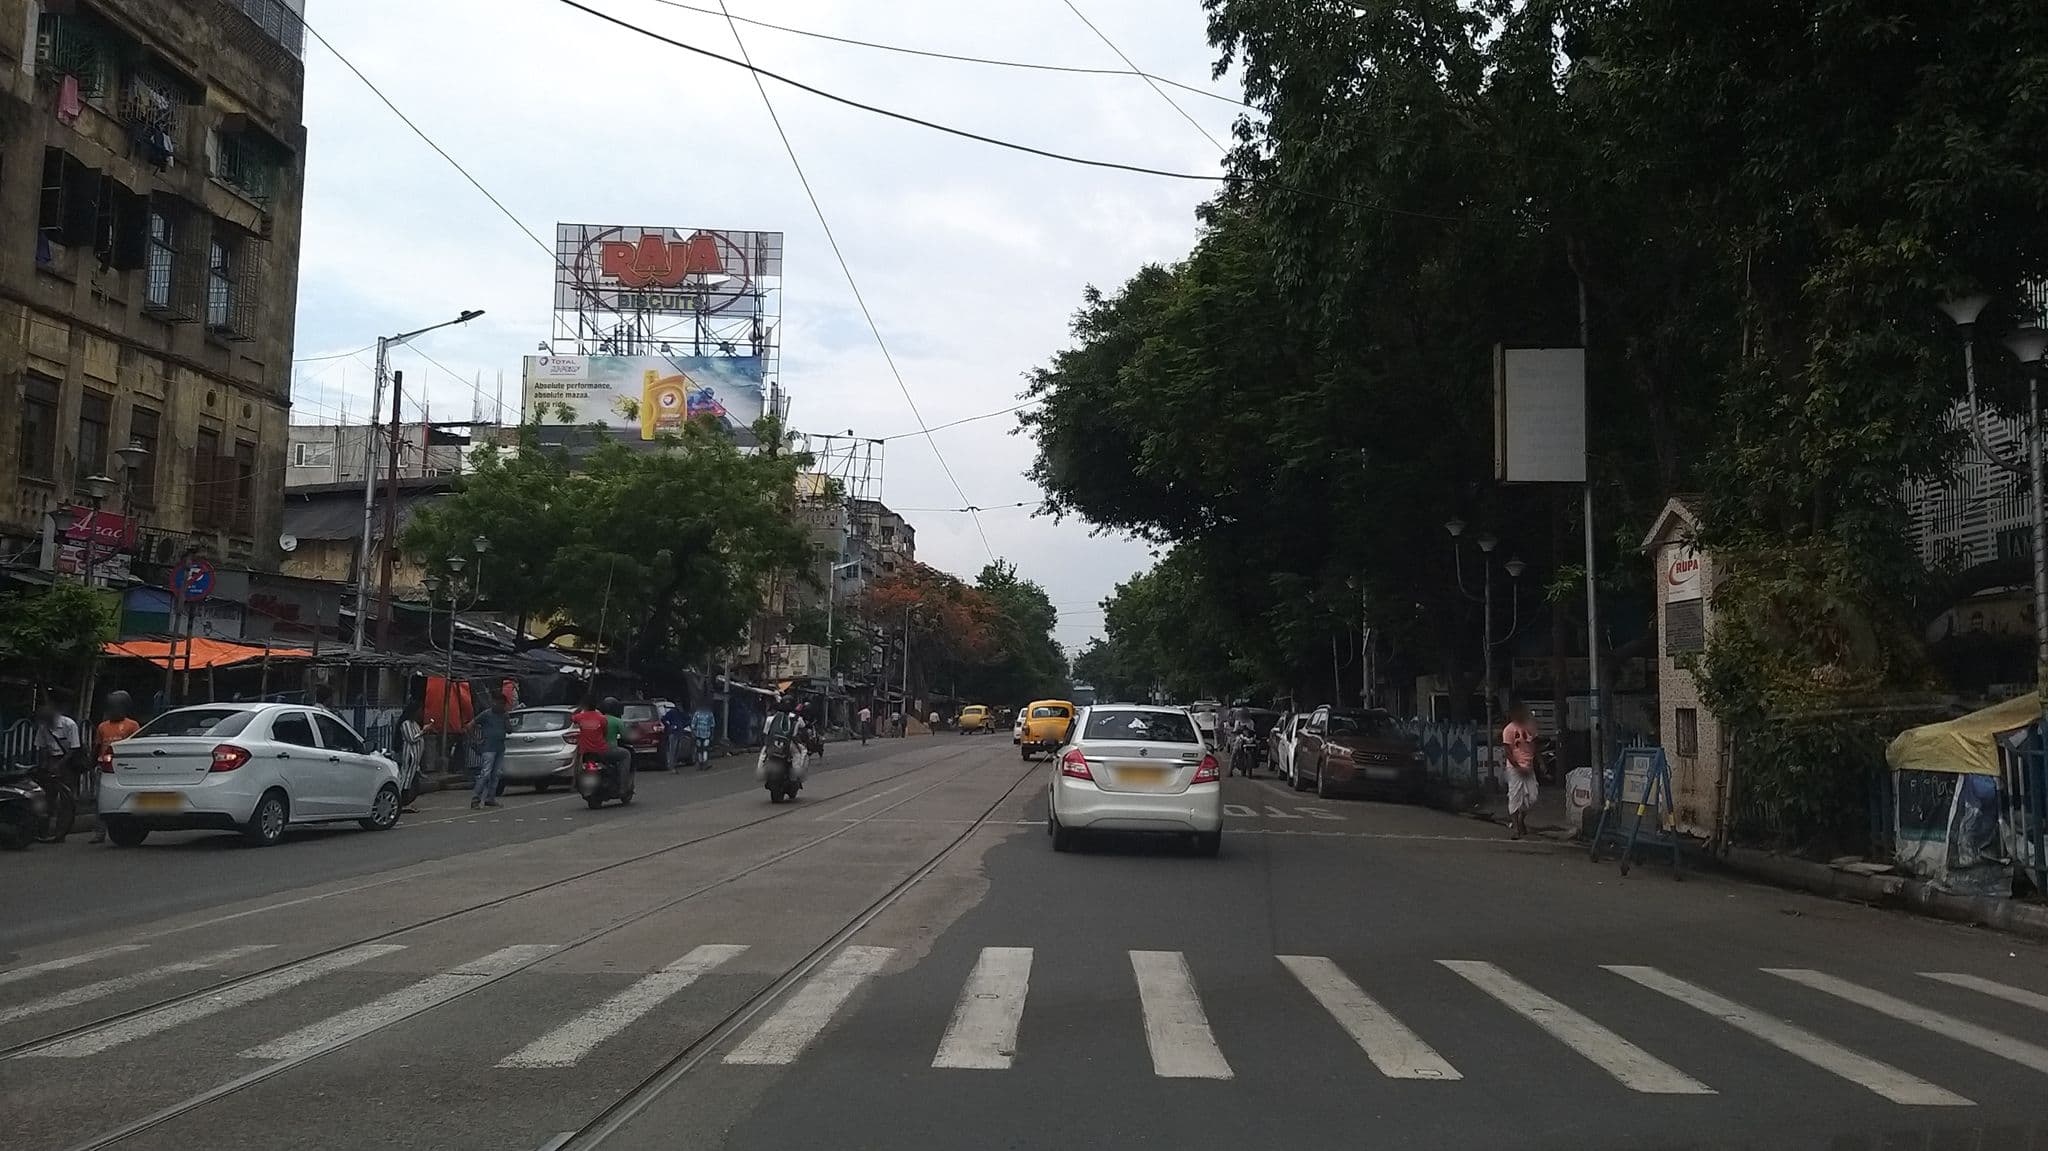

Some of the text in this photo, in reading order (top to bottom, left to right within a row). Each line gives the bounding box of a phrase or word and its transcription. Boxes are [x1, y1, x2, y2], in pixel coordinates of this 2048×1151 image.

[602, 234, 724, 288] RAJA
[618, 294, 706, 310] BISCUITS
[534, 382, 613, 391] Absolute performance,
[533, 391, 564, 399] absolute
[1675, 559, 1699, 574] RUPA
